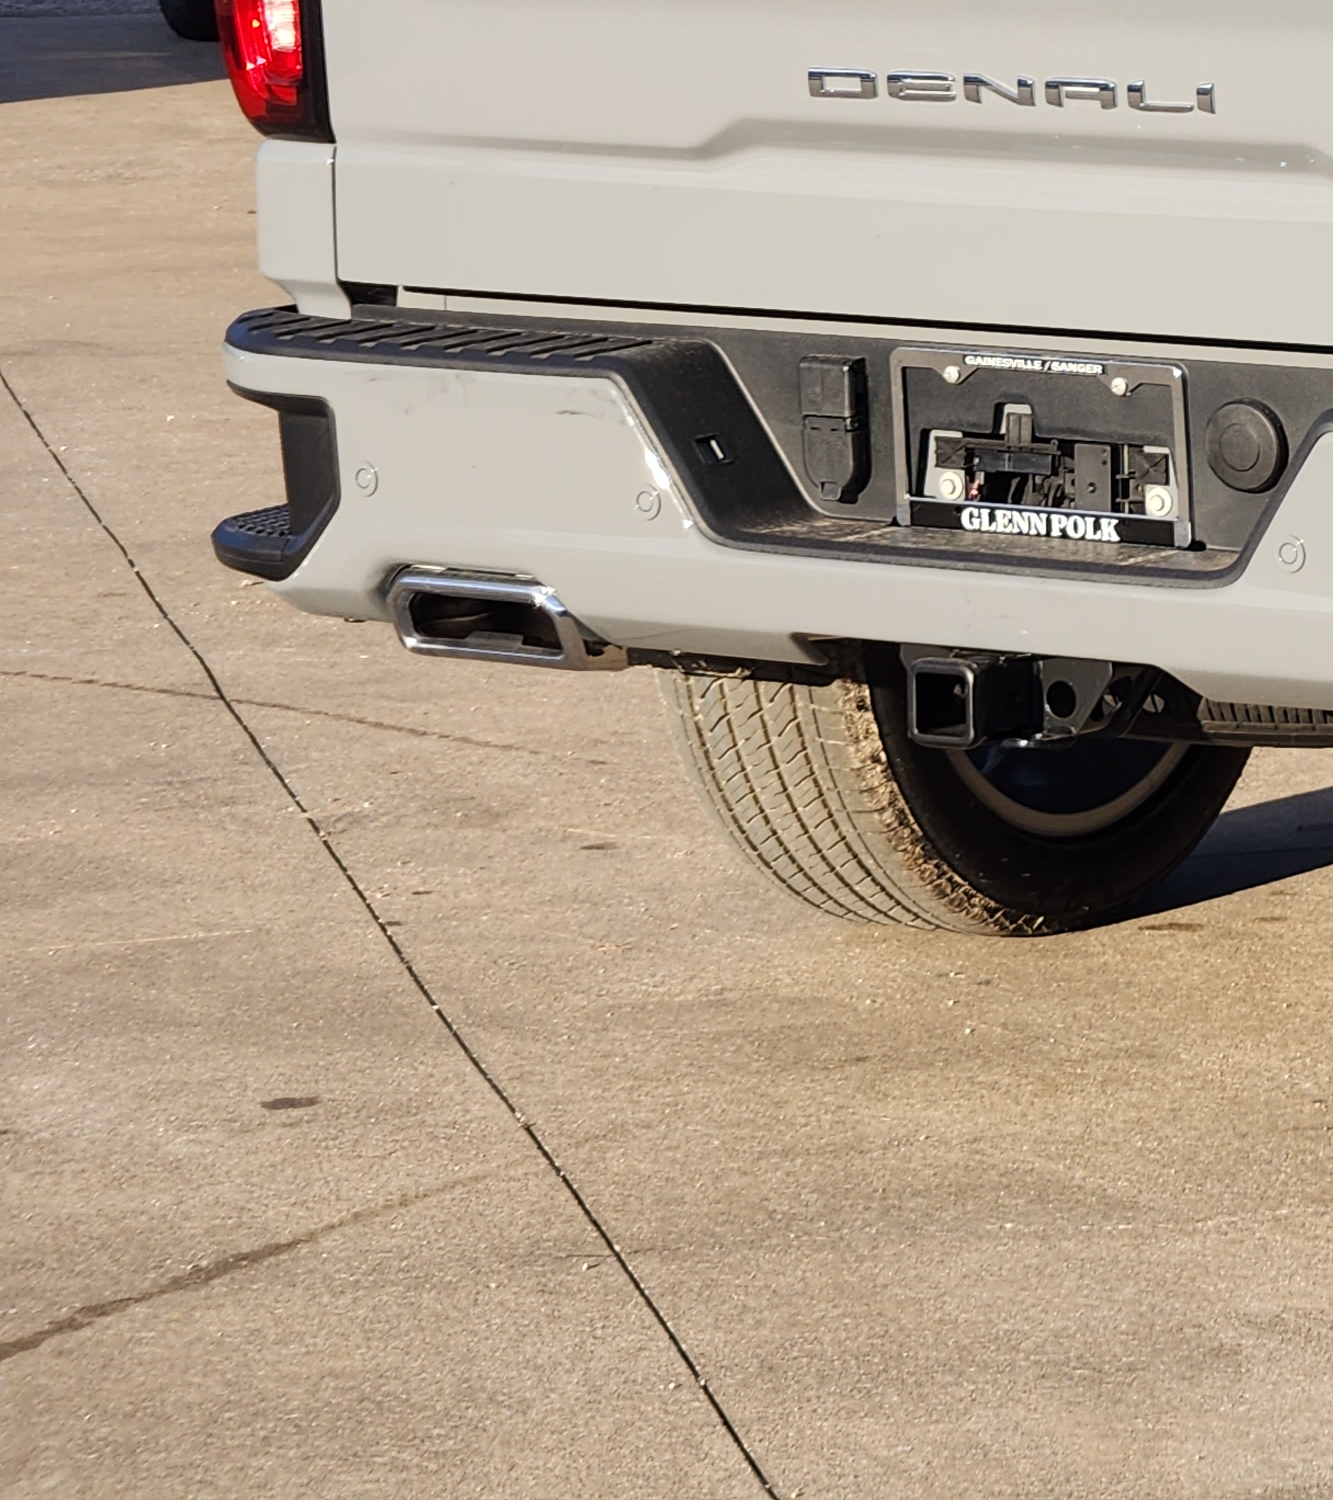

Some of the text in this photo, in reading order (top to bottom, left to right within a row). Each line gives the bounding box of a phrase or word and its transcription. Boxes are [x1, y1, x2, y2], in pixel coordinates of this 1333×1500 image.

[807, 66, 1217, 114] DENALI
[964, 355, 1042, 371] GAINESVILLE
[1051, 360, 1104, 374] SANGER
[960, 506, 1121, 543] GLENN POLK
